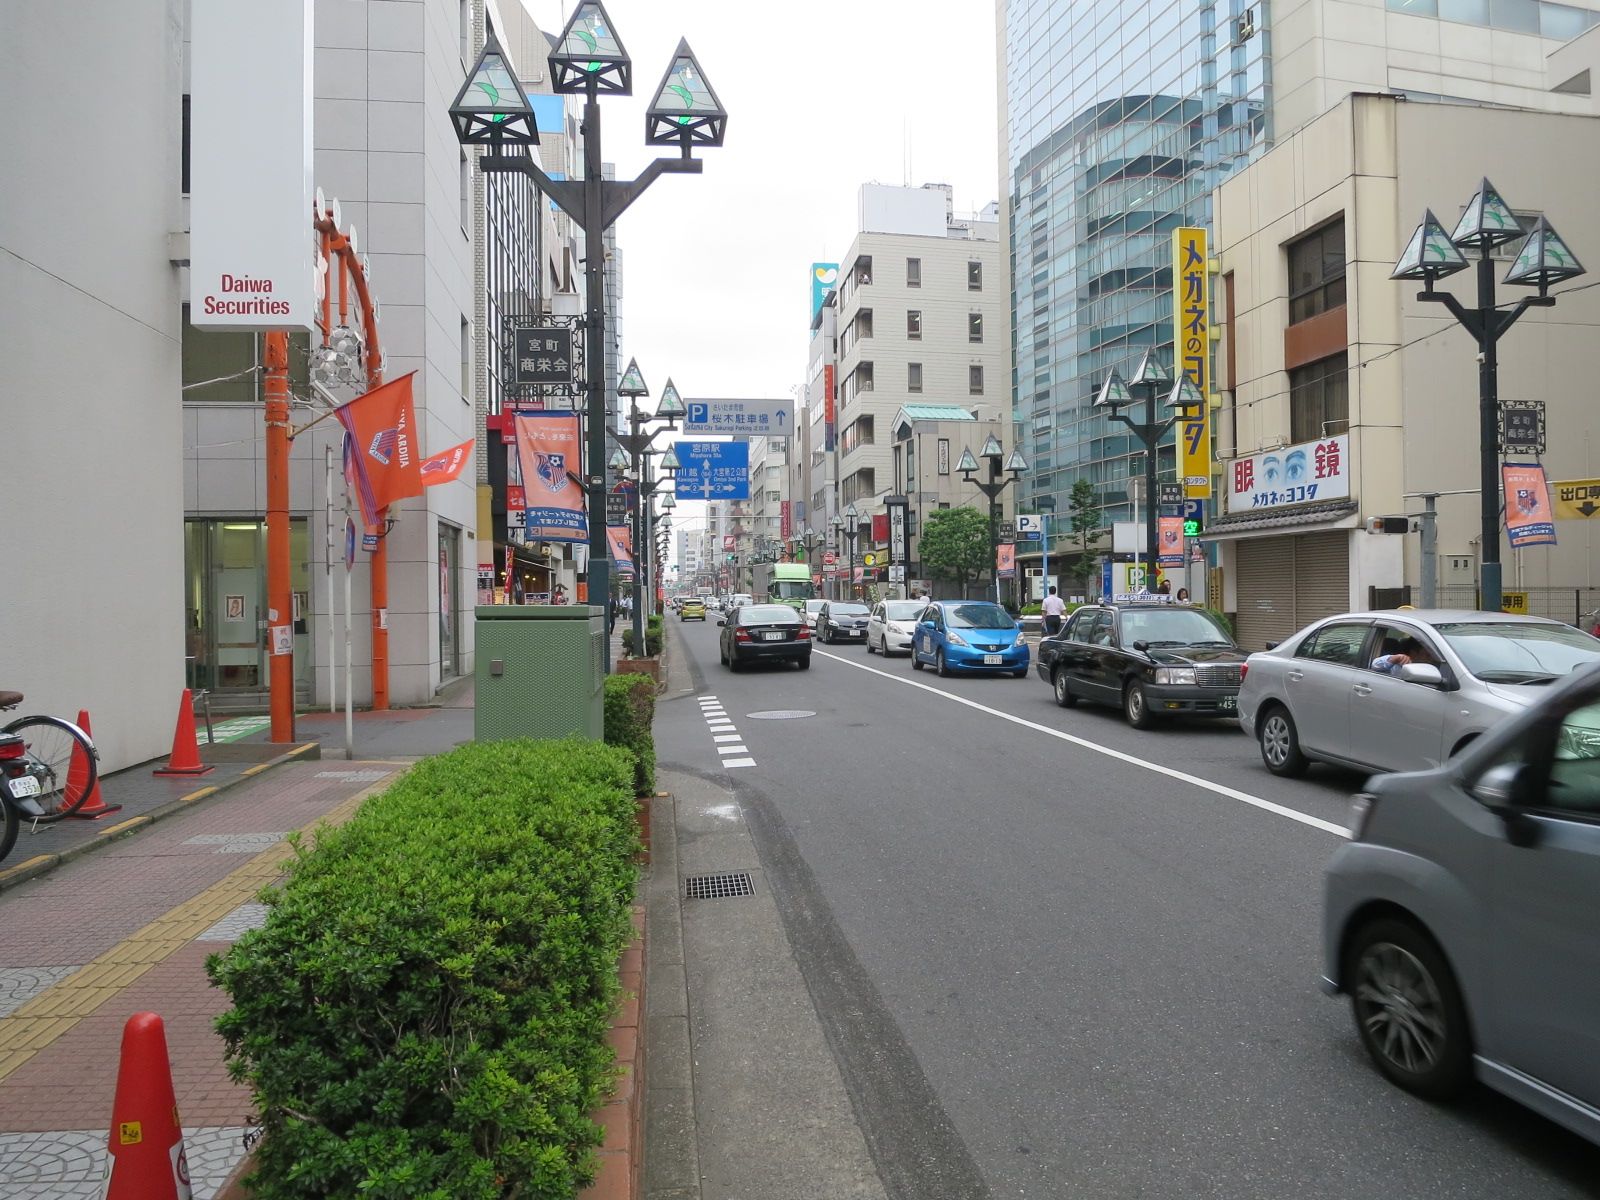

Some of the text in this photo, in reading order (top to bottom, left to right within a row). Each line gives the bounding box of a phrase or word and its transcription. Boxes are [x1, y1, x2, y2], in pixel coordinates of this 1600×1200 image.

[221, 274, 273, 293] Daiwa
[204, 295, 290, 315] Securities
[528, 338, 559, 352] 宮町
[519, 357, 569, 373] 商栄会
[691, 404, 703, 422] P
[711, 413, 769, 424] 桜木駐車場
[1234, 440, 1341, 494] 眼 鏡
[1252, 483, 1319, 508] メガネのヨコタ
[1184, 501, 1198, 518] P
[1019, 517, 1030, 531] P
[1183, 519, 1199, 537] 空
